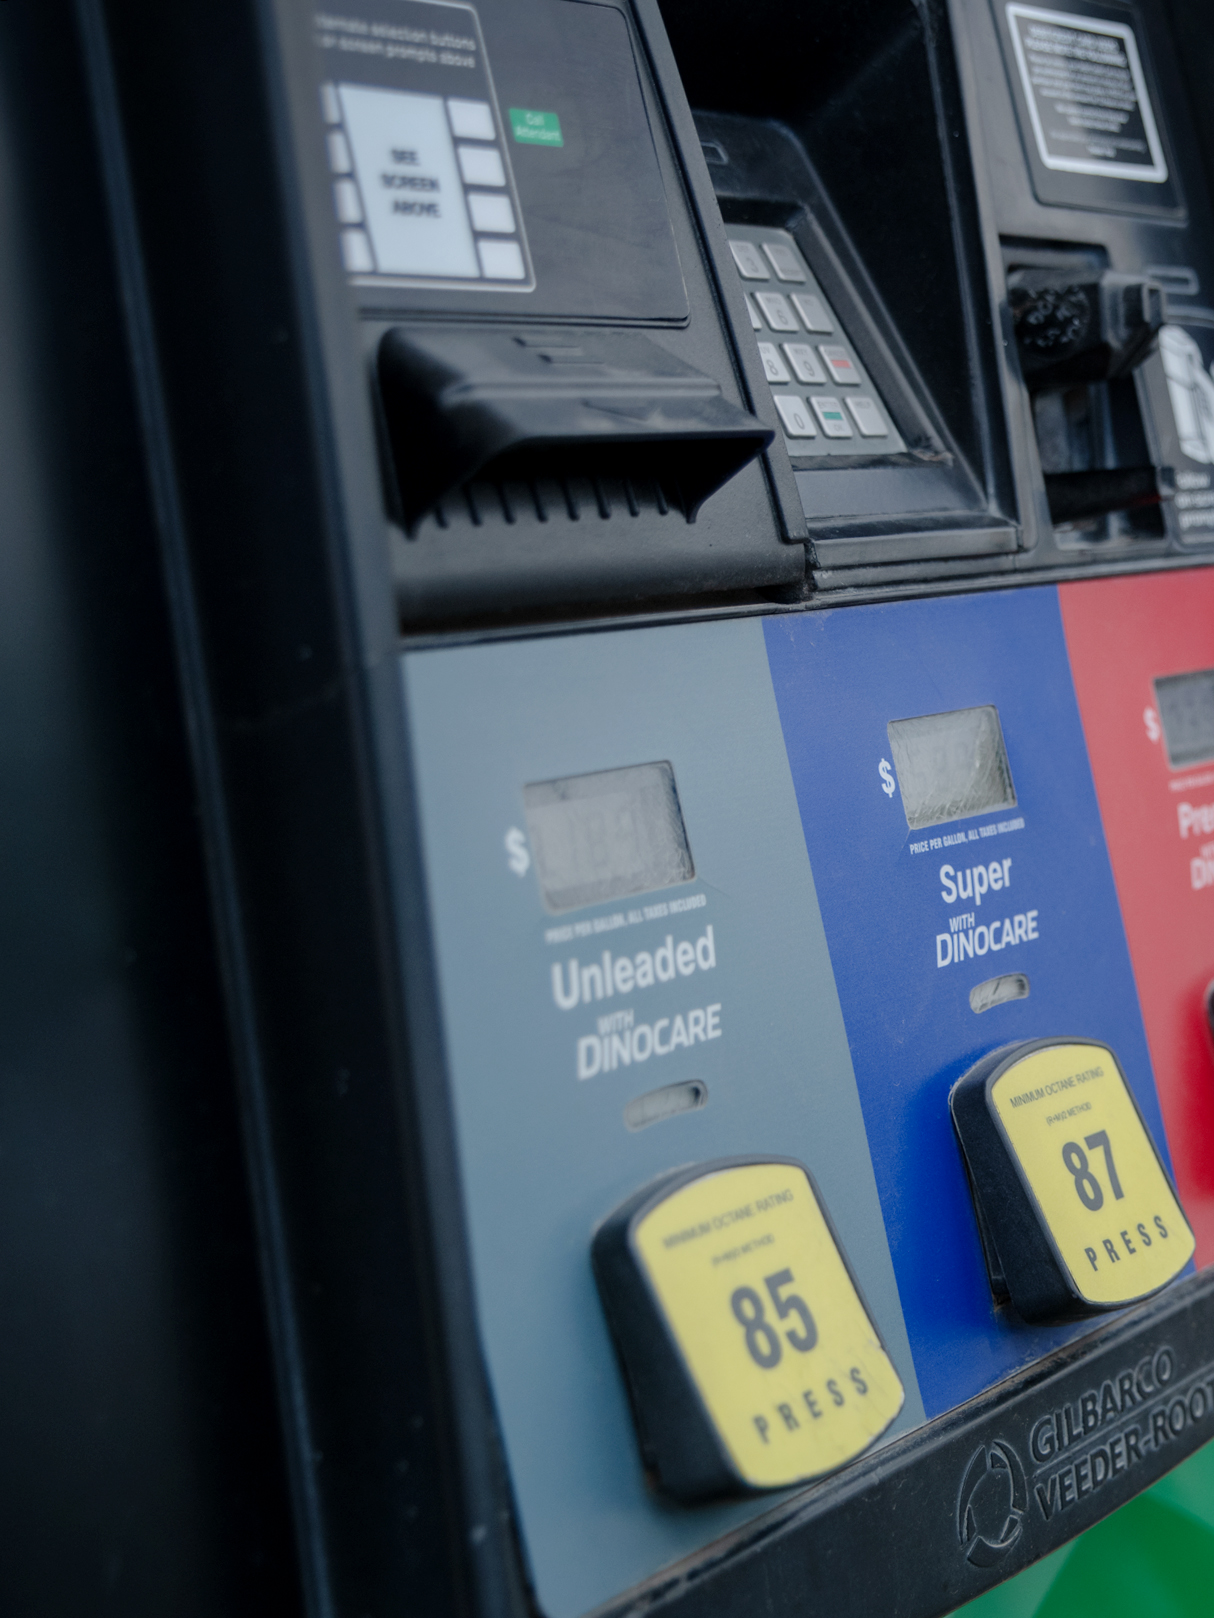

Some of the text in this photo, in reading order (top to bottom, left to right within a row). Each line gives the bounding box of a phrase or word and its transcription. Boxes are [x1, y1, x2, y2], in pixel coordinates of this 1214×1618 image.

[430, 29, 476, 51] buttons
[439, 50, 475, 68] above
[391, 148, 420, 167] SEE
[381, 173, 441, 193] SCREEN
[393, 200, 441, 218] ABOVE
[766, 360, 779, 376] 8
[803, 361, 815, 377] 9
[1143, 706, 1161, 745] $
[878, 758, 896, 798] $
[505, 826, 530, 877] $
[909, 840, 929, 855] PRICE
[929, 837, 943, 850] PER
[968, 829, 979, 841] ALL
[939, 858, 1012, 906] Super
[936, 909, 1040, 968] DINOCARE
[949, 912, 976, 934] WITH
[552, 925, 716, 1010] Unleaded
[577, 1003, 723, 1081] DINOCARE
[596, 1008, 635, 1037] WITH
[1009, 1066, 1104, 1109] MINIMUM OCTANE RATING
[1066, 1101, 1092, 1117] METHOD
[1061, 1129, 1125, 1212] 87
[711, 1202, 757, 1231] OCTANE
[755, 1187, 795, 1213] RATING
[1083, 1215, 1169, 1273] PRESS
[730, 1267, 819, 1370] 85
[752, 1366, 869, 1446] PRESS
[1029, 1346, 1176, 1464] GILBARCO
